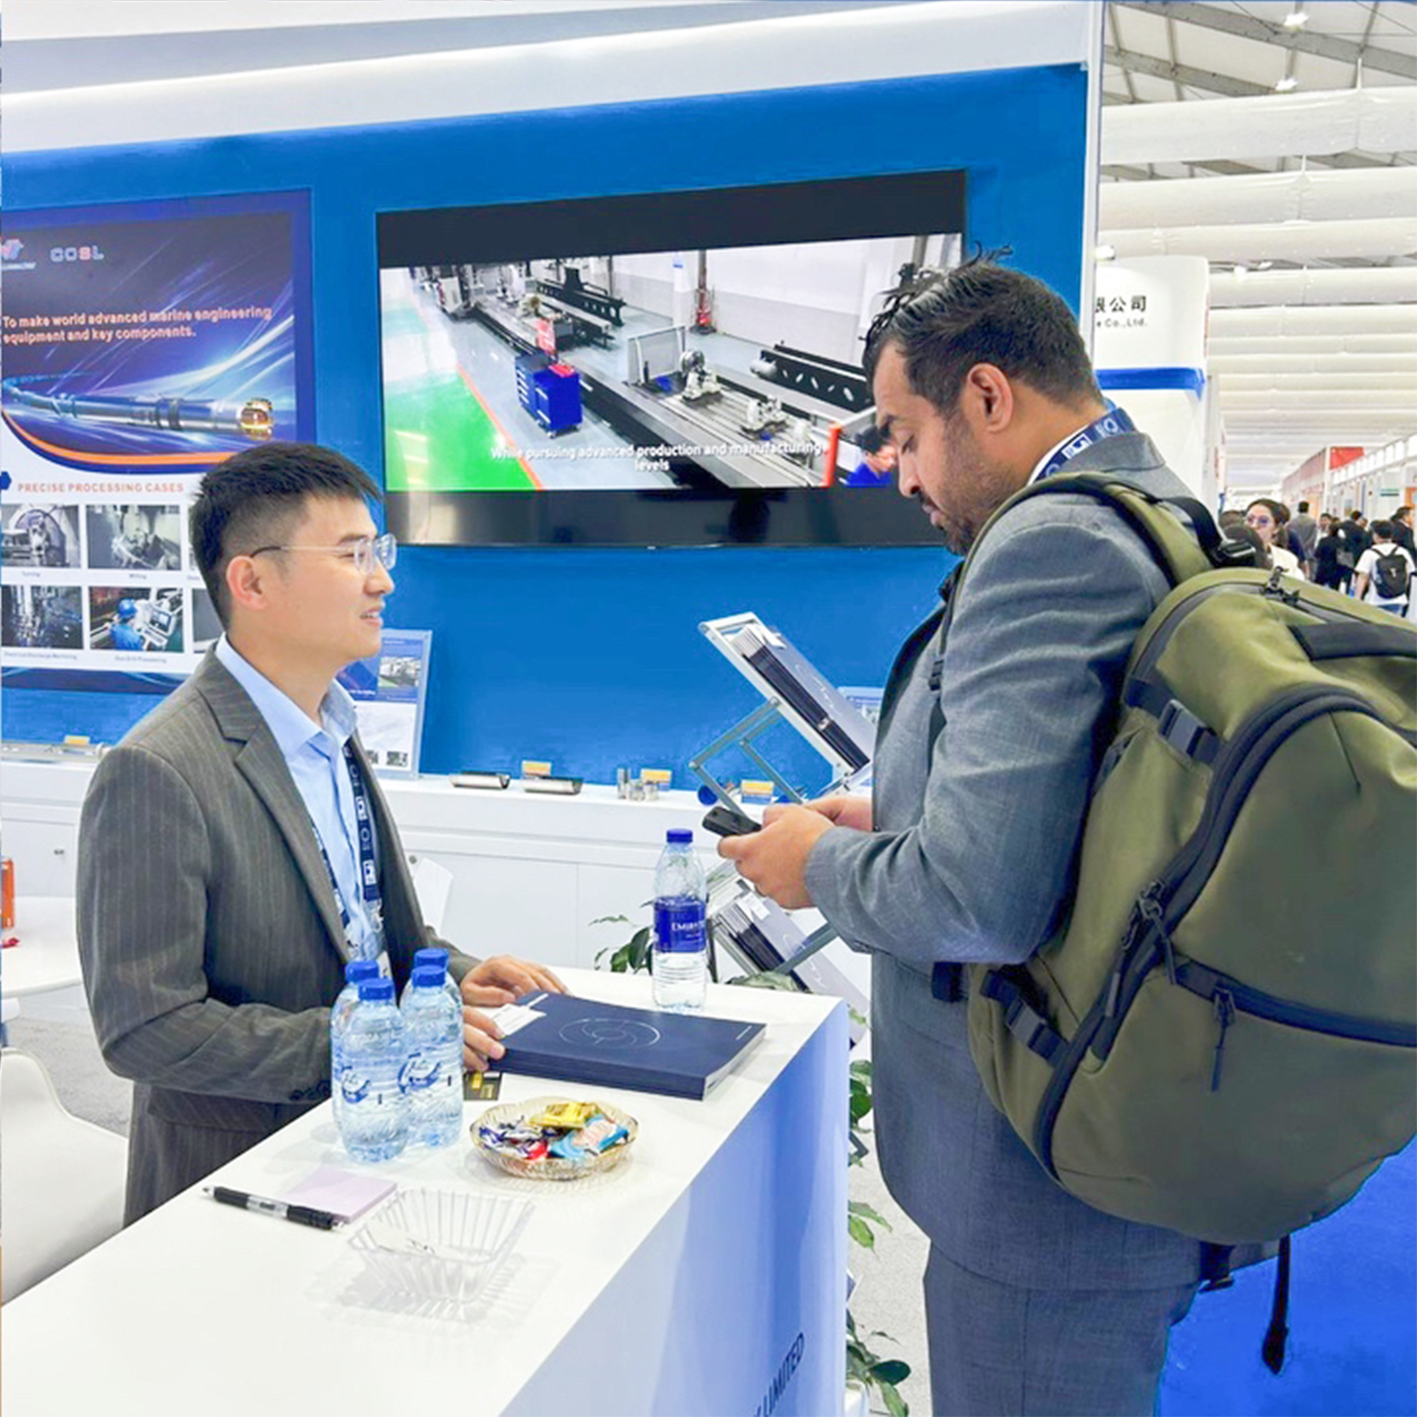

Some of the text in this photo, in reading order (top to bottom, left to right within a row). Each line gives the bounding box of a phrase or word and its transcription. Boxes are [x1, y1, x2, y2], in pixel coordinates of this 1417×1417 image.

[3, 305, 272, 327] To make world advanced marine engineering
[3, 325, 196, 345] equipment and key components.
[492, 447, 524, 460] While
[526, 446, 575, 462] pursuing
[578, 444, 634, 459] advanced
[636, 443, 703, 458] production
[705, 443, 727, 455] and
[635, 458, 670, 471] levels
[18, 483, 184, 492] PRECISE PROCESSING CASES
